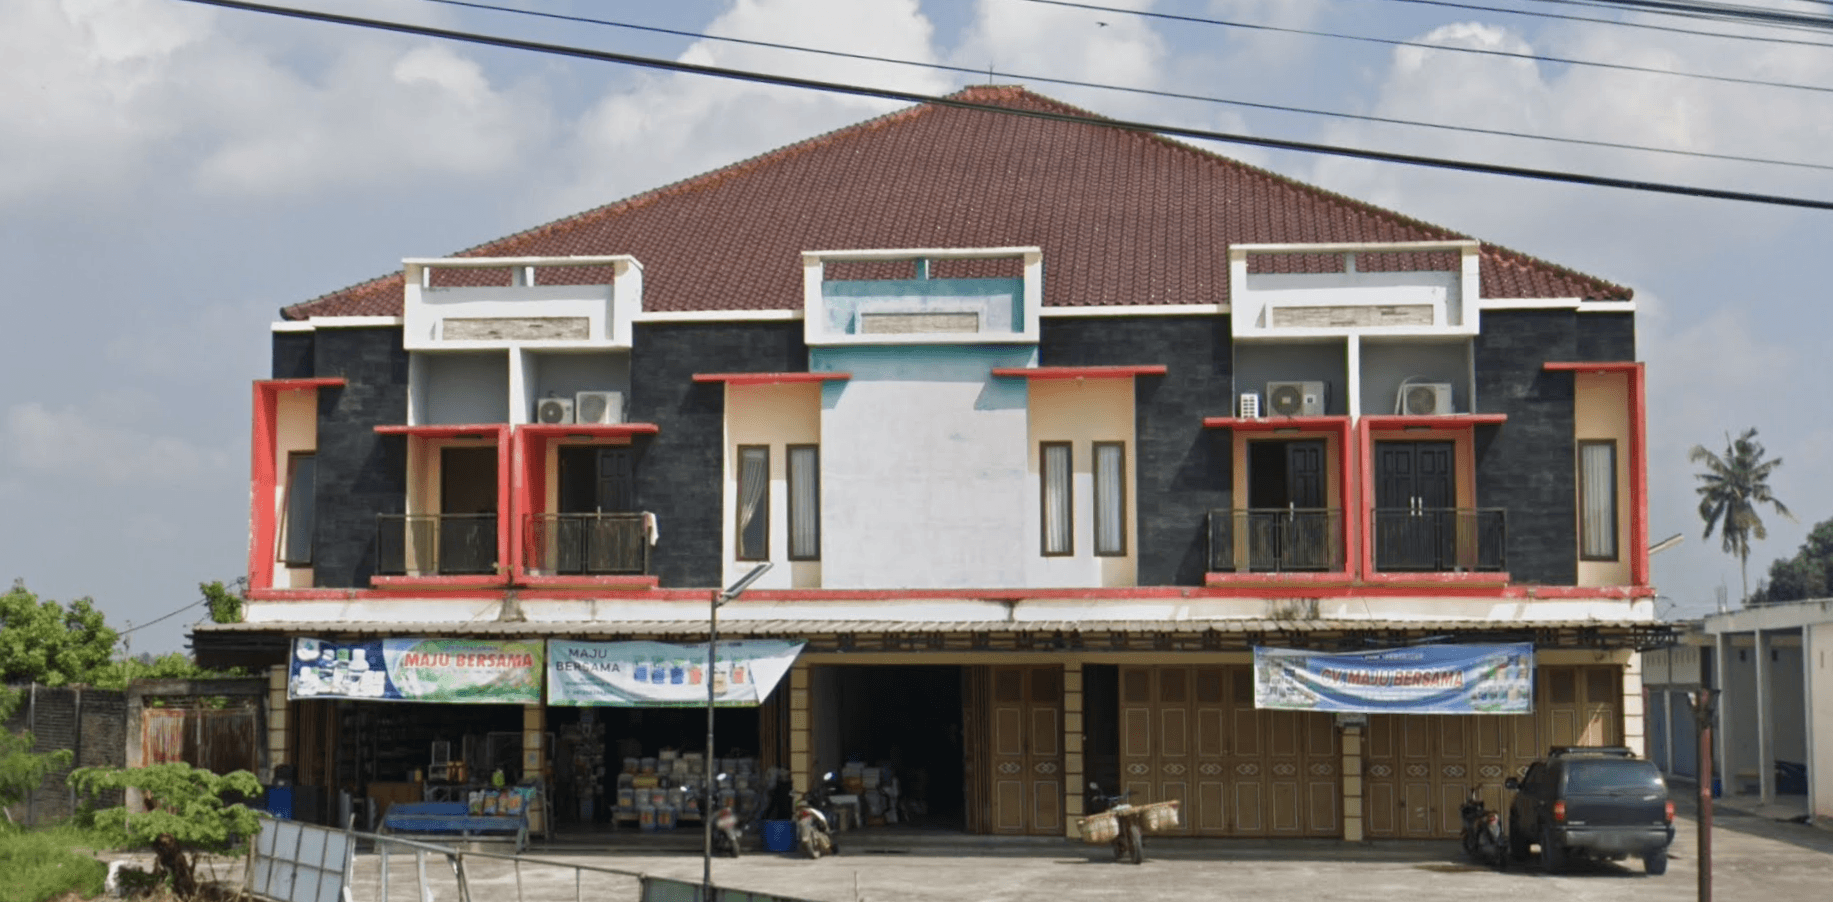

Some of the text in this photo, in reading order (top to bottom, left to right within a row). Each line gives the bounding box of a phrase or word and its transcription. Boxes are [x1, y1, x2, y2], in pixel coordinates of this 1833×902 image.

[568, 648, 607, 659] MAJU
[403, 653, 534, 668] MAJU BERSAMA
[555, 661, 621, 673] BERSAMA
[1346, 671, 1388, 686] MAJU
[1394, 671, 1463, 687] BERSAMA
